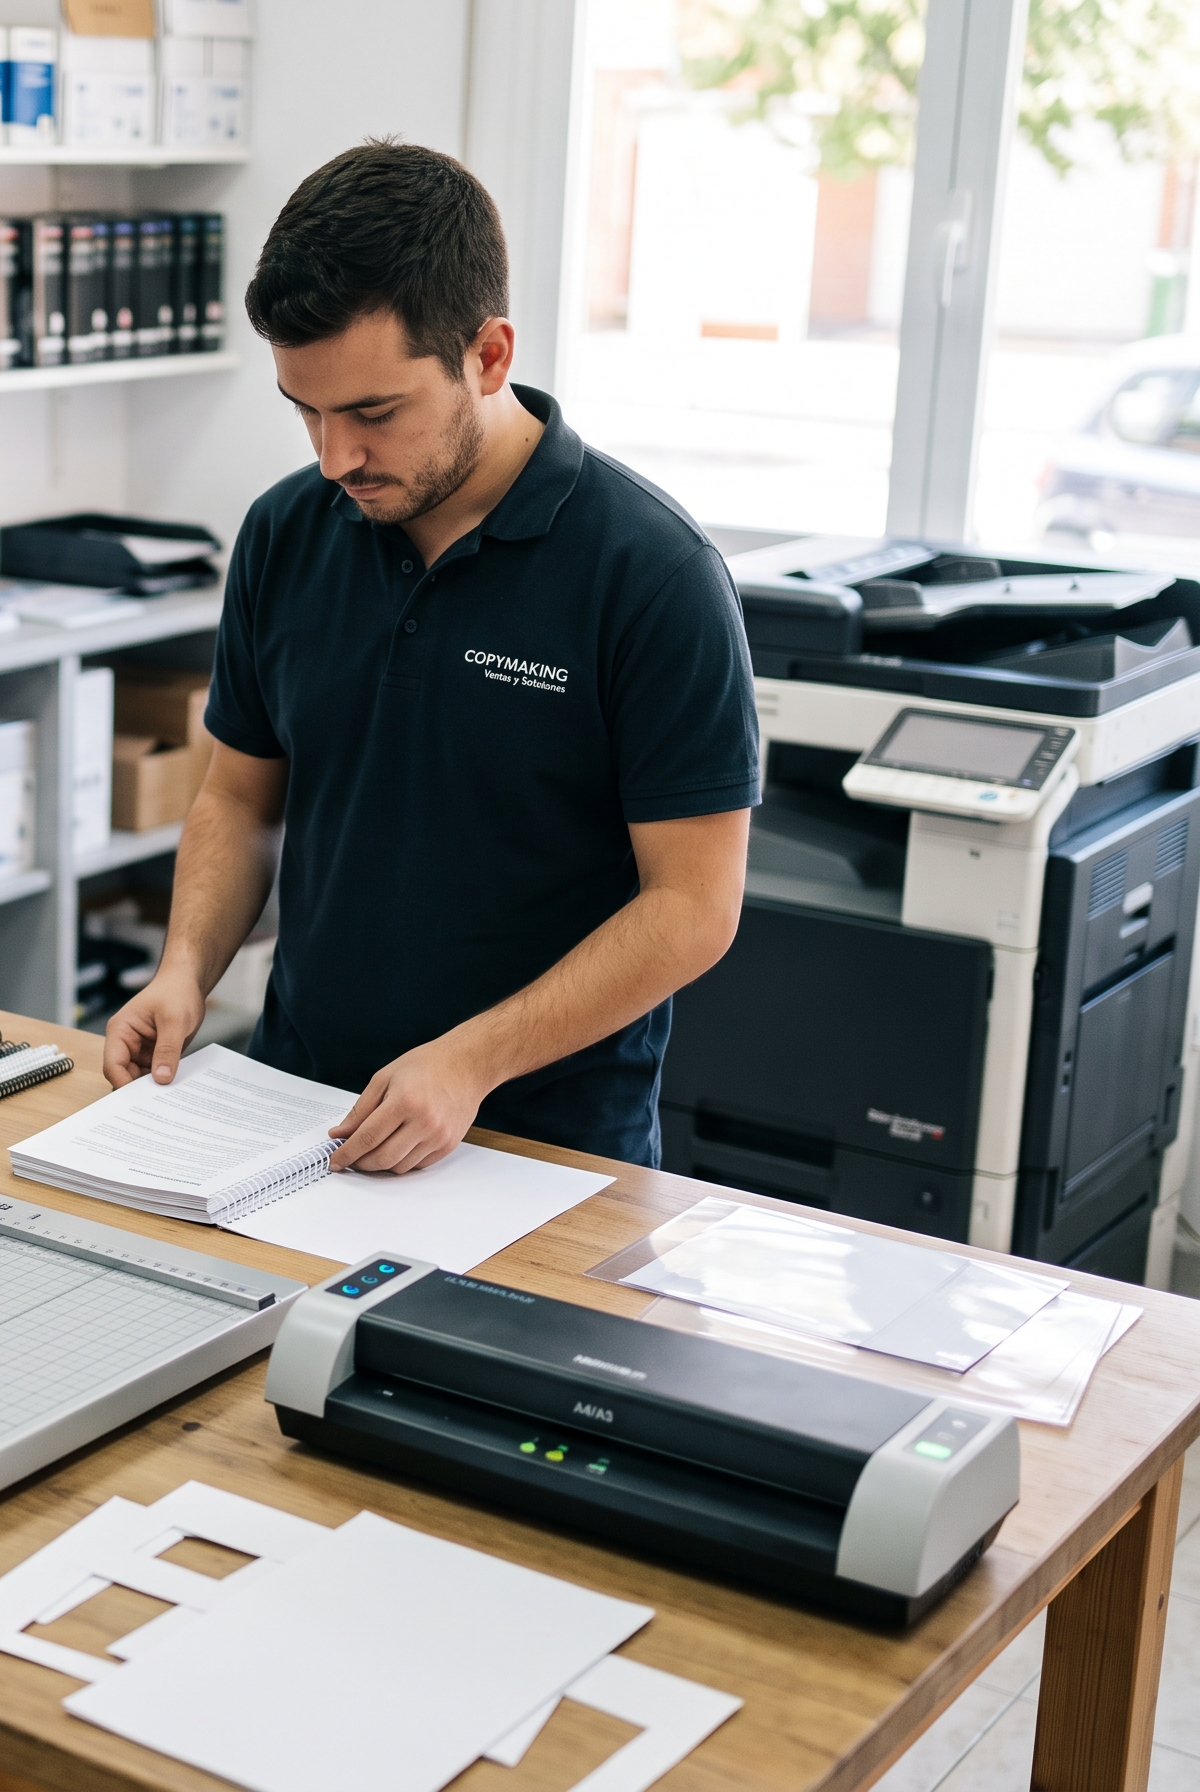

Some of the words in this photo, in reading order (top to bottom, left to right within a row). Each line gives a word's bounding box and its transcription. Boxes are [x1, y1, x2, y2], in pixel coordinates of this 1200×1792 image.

[464, 649, 569, 682] COPYMAKING
[513, 677, 520, 686] y
[573, 1401, 615, 1424] A4/A3
